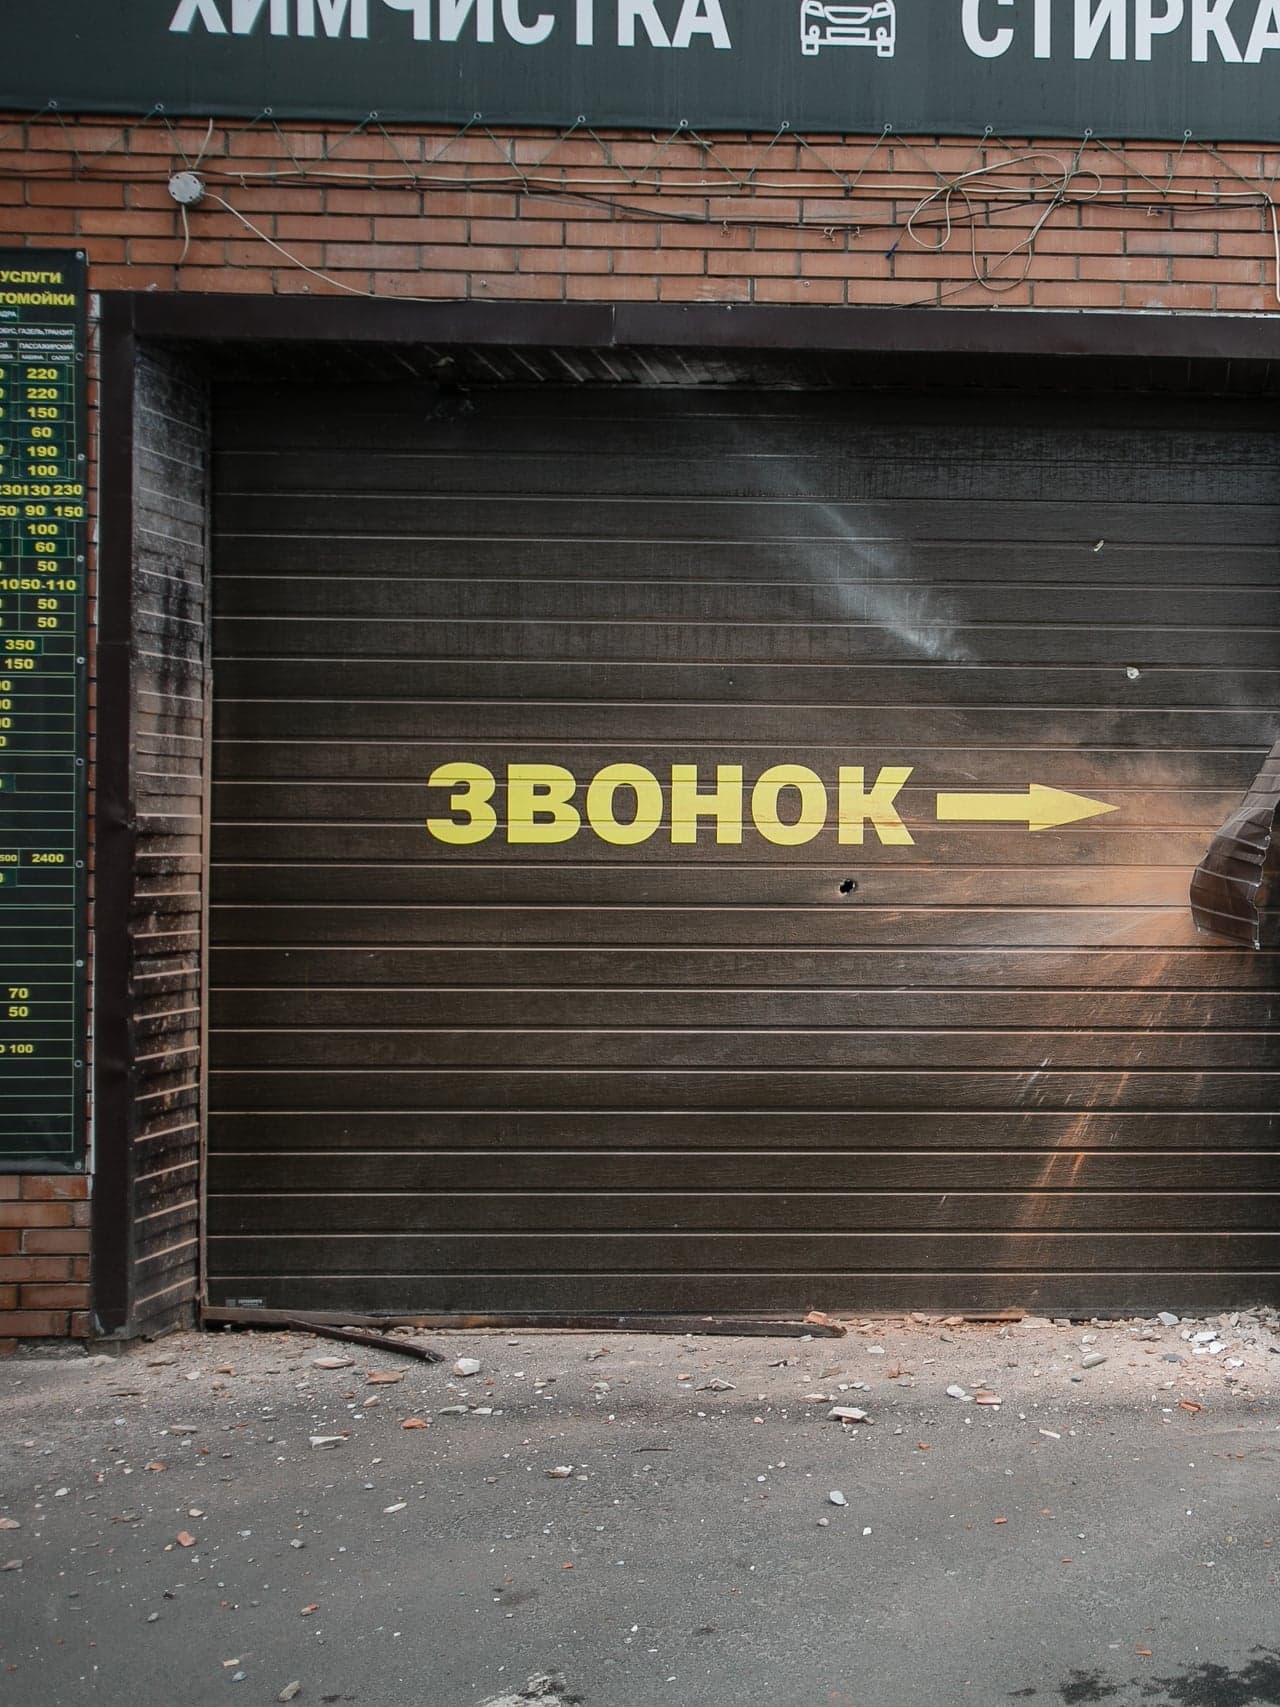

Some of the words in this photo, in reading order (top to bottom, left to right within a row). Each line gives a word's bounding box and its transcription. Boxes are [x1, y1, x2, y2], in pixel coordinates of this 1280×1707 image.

[0, 270, 63, 284] УСЛУГИ
[26, 368, 58, 380] 220
[26, 388, 58, 399] 220
[27, 407, 58, 418] 150
[31, 426, 52, 438] 60
[27, 446, 58, 457] 190
[27, 465, 58, 476] 100
[53, 485, 82, 496] 230
[24, 505, 46, 516] 90
[54, 506, 84, 517] 150
[27, 524, 58, 535] 100
[34, 542, 56, 553] 60
[37, 561, 58, 572] 50
[37, 599, 58, 610] 50
[37, 617, 57, 628] 50
[4, 639, 35, 650] 350
[4, 659, 34, 669] 150
[426, 762, 916, 846] ЗВОНОК
[31, 853, 65, 863] 2400
[8, 988, 29, 999] 70
[8, 1006, 29, 1017] 50
[9, 1044, 34, 1054] 100
